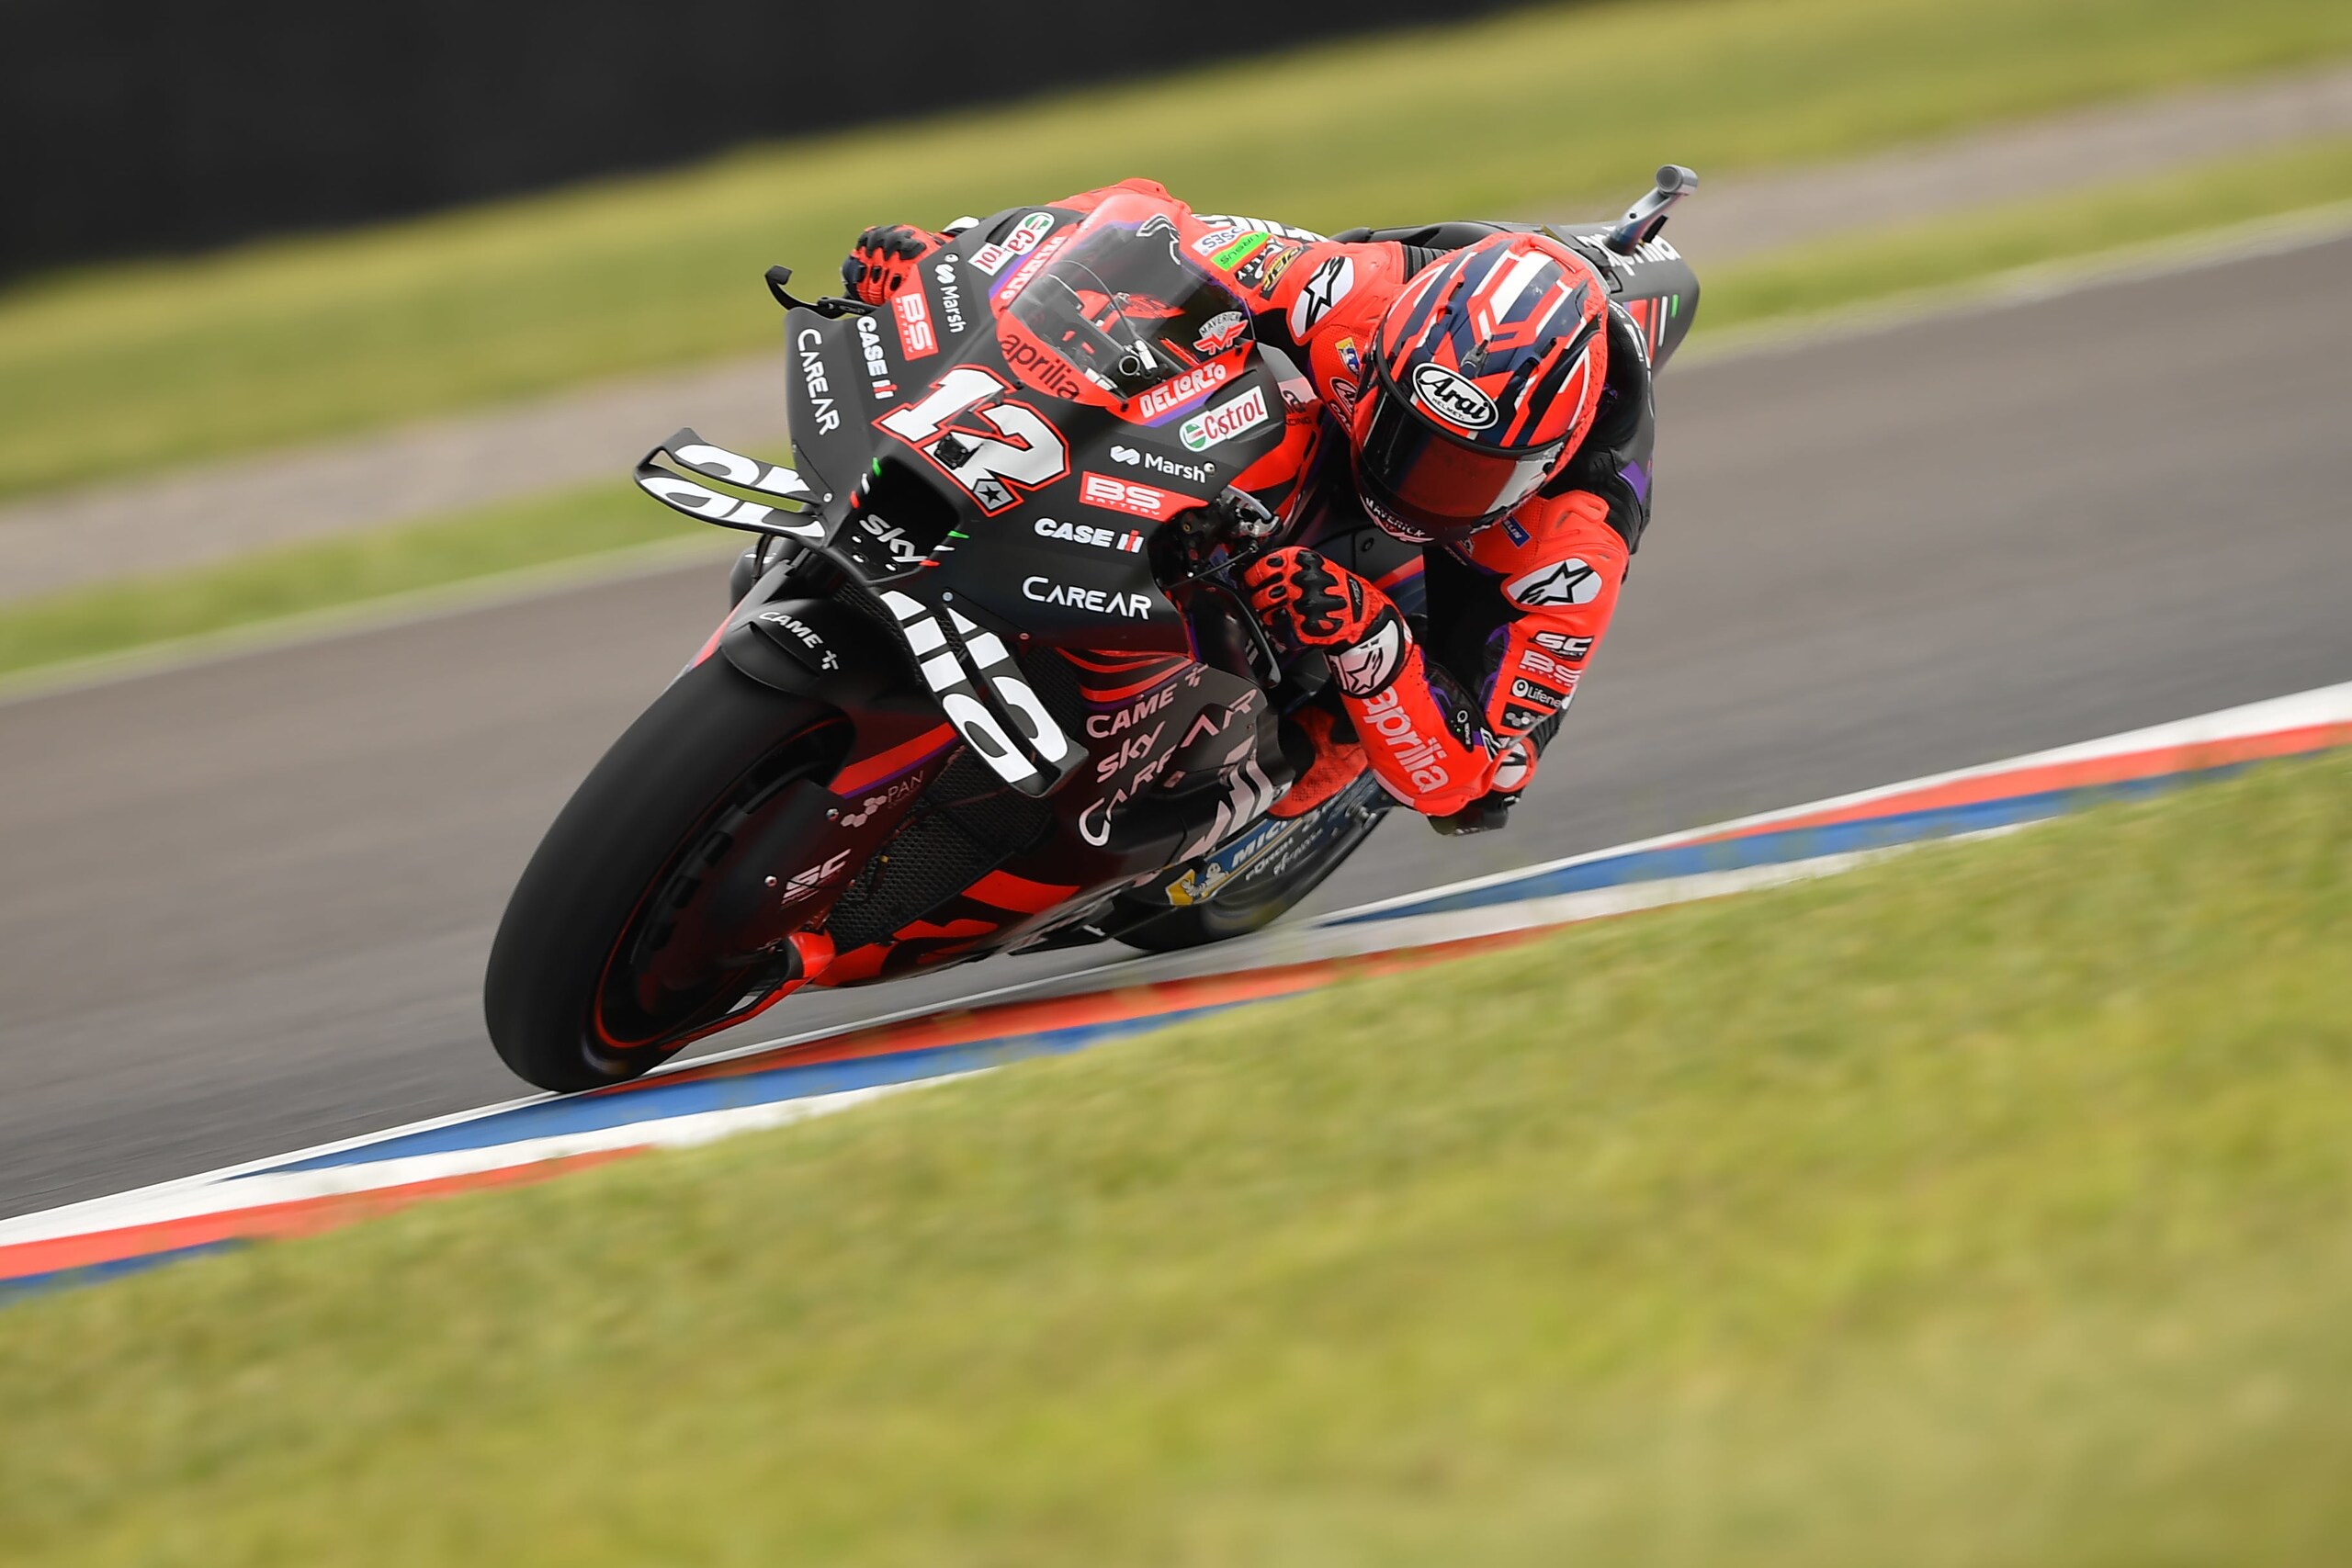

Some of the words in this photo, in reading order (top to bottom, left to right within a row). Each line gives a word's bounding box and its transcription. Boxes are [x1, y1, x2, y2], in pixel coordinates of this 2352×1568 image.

[900, 292, 934, 351] BS
[940, 285, 967, 333] Marsh
[1200, 312, 1241, 336] MAVERICK
[856, 316, 888, 377] CASE
[1000, 332, 1080, 401] aprilia
[797, 328, 841, 435] CAREAR
[1139, 364, 1227, 419] DELLORTO
[1418, 377, 1489, 420] Arai
[872, 365, 1070, 516] 12
[1144, 455, 1205, 484] Marsh
[1085, 476, 1162, 511] BS
[1085, 495, 1161, 516] BATTERY
[1034, 517, 1114, 548] CASE
[1365, 497, 1425, 537] MAVERICK
[1022, 576, 1153, 620] CAREAR
[759, 612, 824, 649] CAME
[1535, 632, 1593, 653] SC
[1521, 649, 1582, 683] BS
[1086, 683, 1178, 739] CAME
[1097, 720, 1166, 784] sky
[1361, 686, 1451, 795] aprilia
